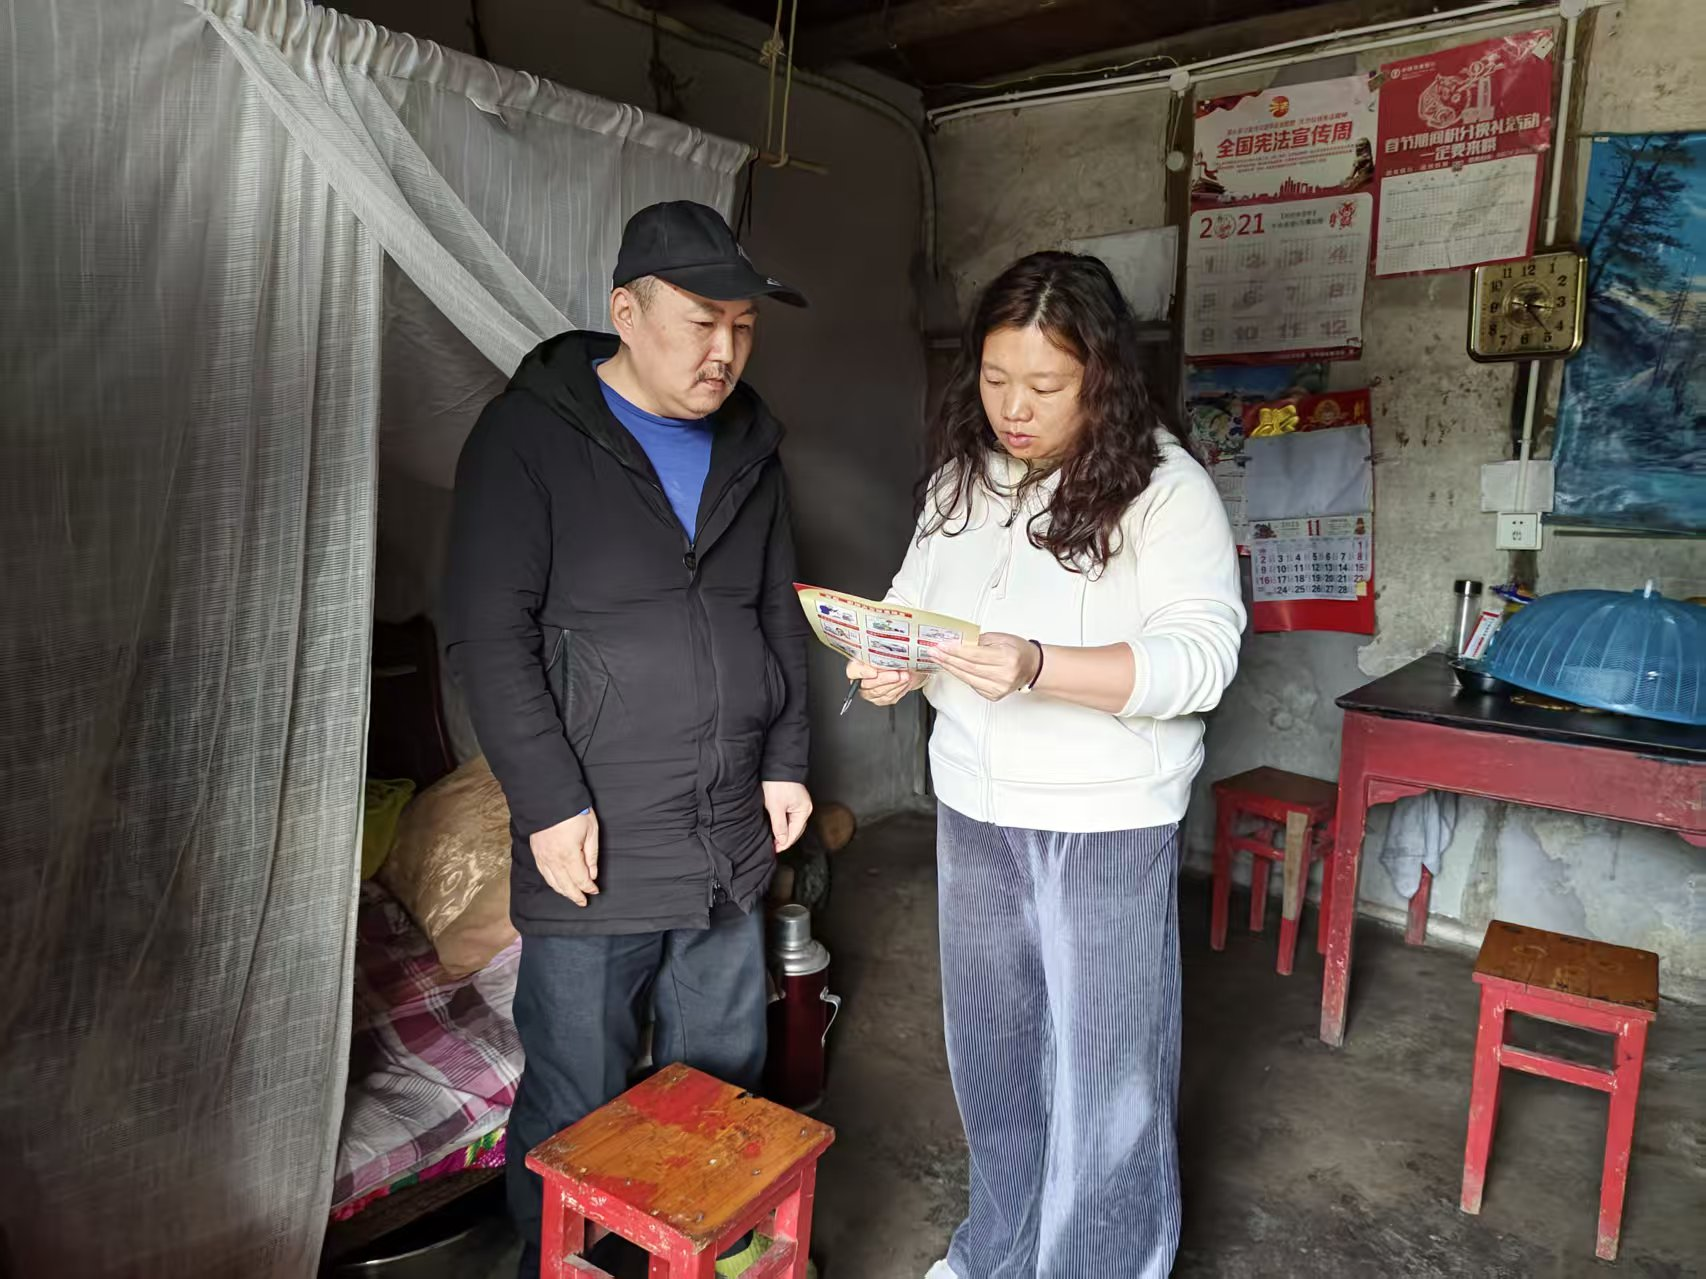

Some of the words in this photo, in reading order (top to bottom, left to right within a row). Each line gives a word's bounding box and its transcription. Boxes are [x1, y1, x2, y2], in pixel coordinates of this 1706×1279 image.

[1216, 121, 1353, 159] 全国宪法宣传周
[1503, 267, 1513, 279] 11
[1521, 264, 1536, 277] 12
[1549, 262, 1556, 274] 1
[1557, 275, 1568, 287] 2
[1556, 296, 1566, 308] 3
[1555, 320, 1564, 331] 4
[1499, 335, 1508, 346] 7
[1520, 333, 1529, 344] 6
[1543, 332, 1553, 343] 5
[1307, 519, 1321, 536] 11
[1260, 556, 1266, 564] 2
[1278, 554, 1284, 563] 3
[1295, 553, 1302, 561] 4
[1312, 553, 1318, 561] 5
[1325, 553, 1331, 561] 6
[1340, 553, 1346, 561] 7
[1261, 566, 1267, 574] 9
[1277, 565, 1287, 573] 10
[1294, 564, 1304, 572] 11
[1312, 563, 1320, 571] 12
[1324, 563, 1333, 571] 13
[1338, 563, 1348, 571] 14
[1355, 563, 1364, 571] 15
[1260, 576, 1270, 584] 16
[1295, 575, 1305, 583] 18
[1312, 574, 1321, 582] 19
[1325, 574, 1333, 582] 20
[1338, 574, 1347, 582] 21
[1277, 586, 1288, 594] 24
[1295, 585, 1305, 593] 25
[1312, 584, 1321, 593] 26
[1325, 584, 1334, 592] 27
[1338, 585, 1348, 594] 28
